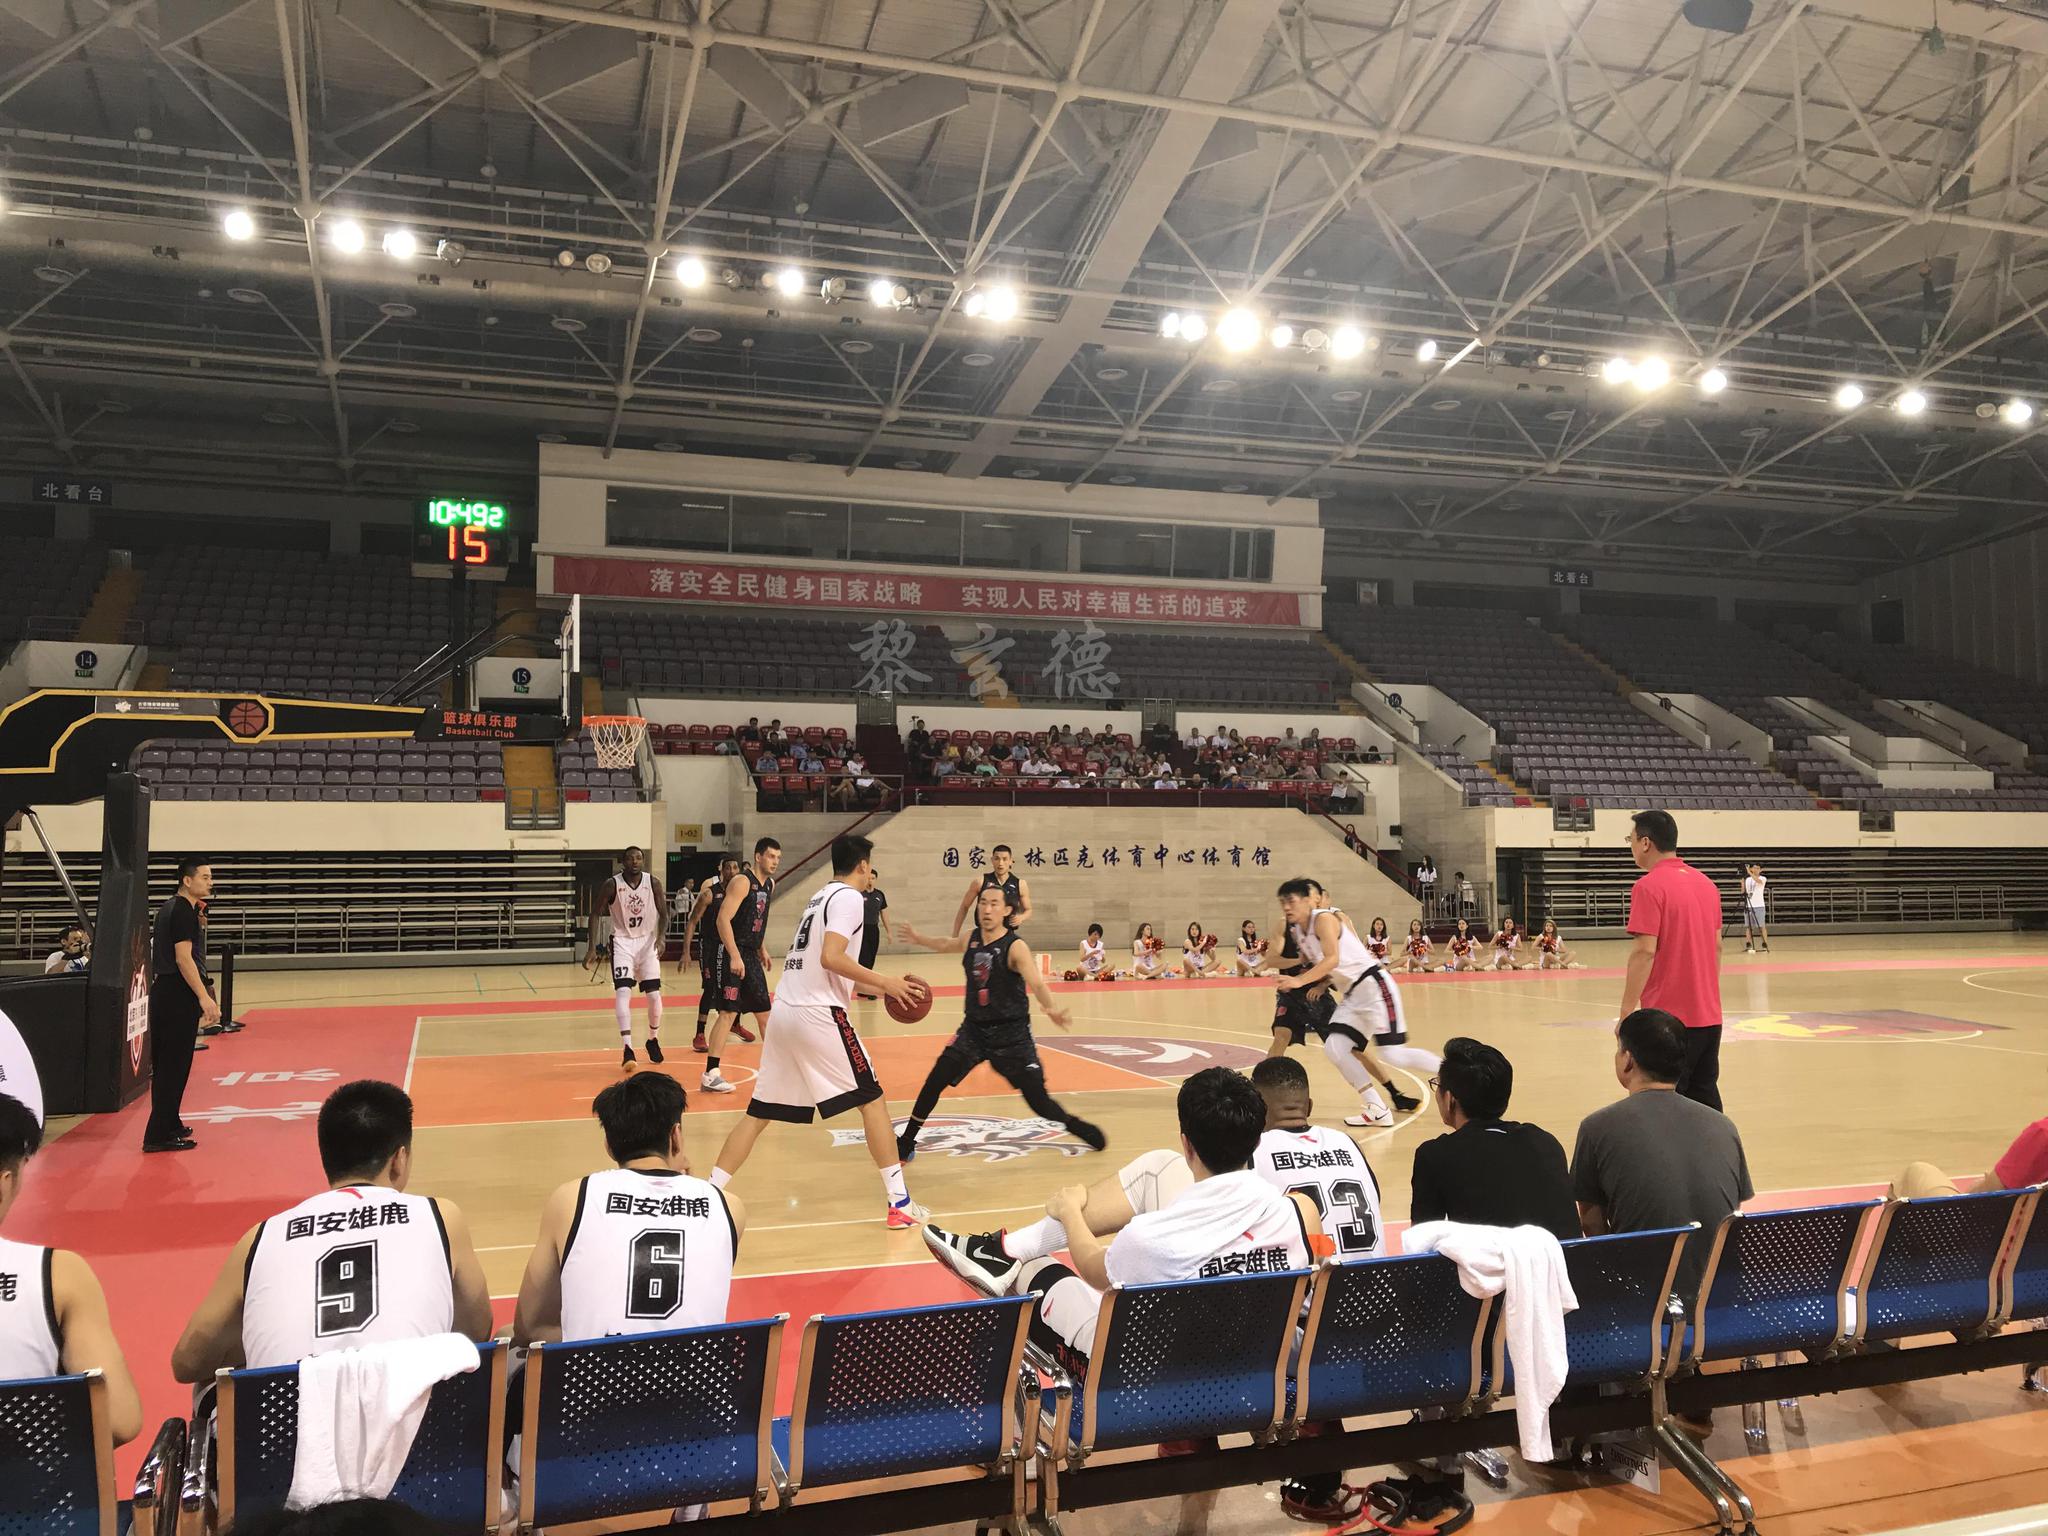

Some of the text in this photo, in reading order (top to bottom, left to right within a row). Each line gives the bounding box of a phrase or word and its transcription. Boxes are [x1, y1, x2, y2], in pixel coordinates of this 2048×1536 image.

[41, 482, 103, 502] 北看台
[448, 525, 488, 563] 15
[1554, 571, 1590, 585] 北看台
[650, 567, 1249, 619] 落实全民健身国家战略 实现人民对幸福生活的追求
[80, 654, 93, 667] 14
[516, 671, 528, 683] 15
[443, 711, 517, 729] 篮球俱乐部
[445, 726, 515, 738] Basketball Club
[943, 844, 1272, 869] 国家林匹克体育中心体育馆
[628, 916, 644, 928] 37
[615, 966, 629, 979] 37
[1271, 1148, 1355, 1171] 国安雄鹿
[606, 1191, 710, 1219] 国安雄鹿
[286, 1201, 410, 1241] 国安雄鹿
[625, 1228, 686, 1321] 6
[1200, 1247, 1291, 1279] 国安雄鹿
[315, 1239, 380, 1339] 9
